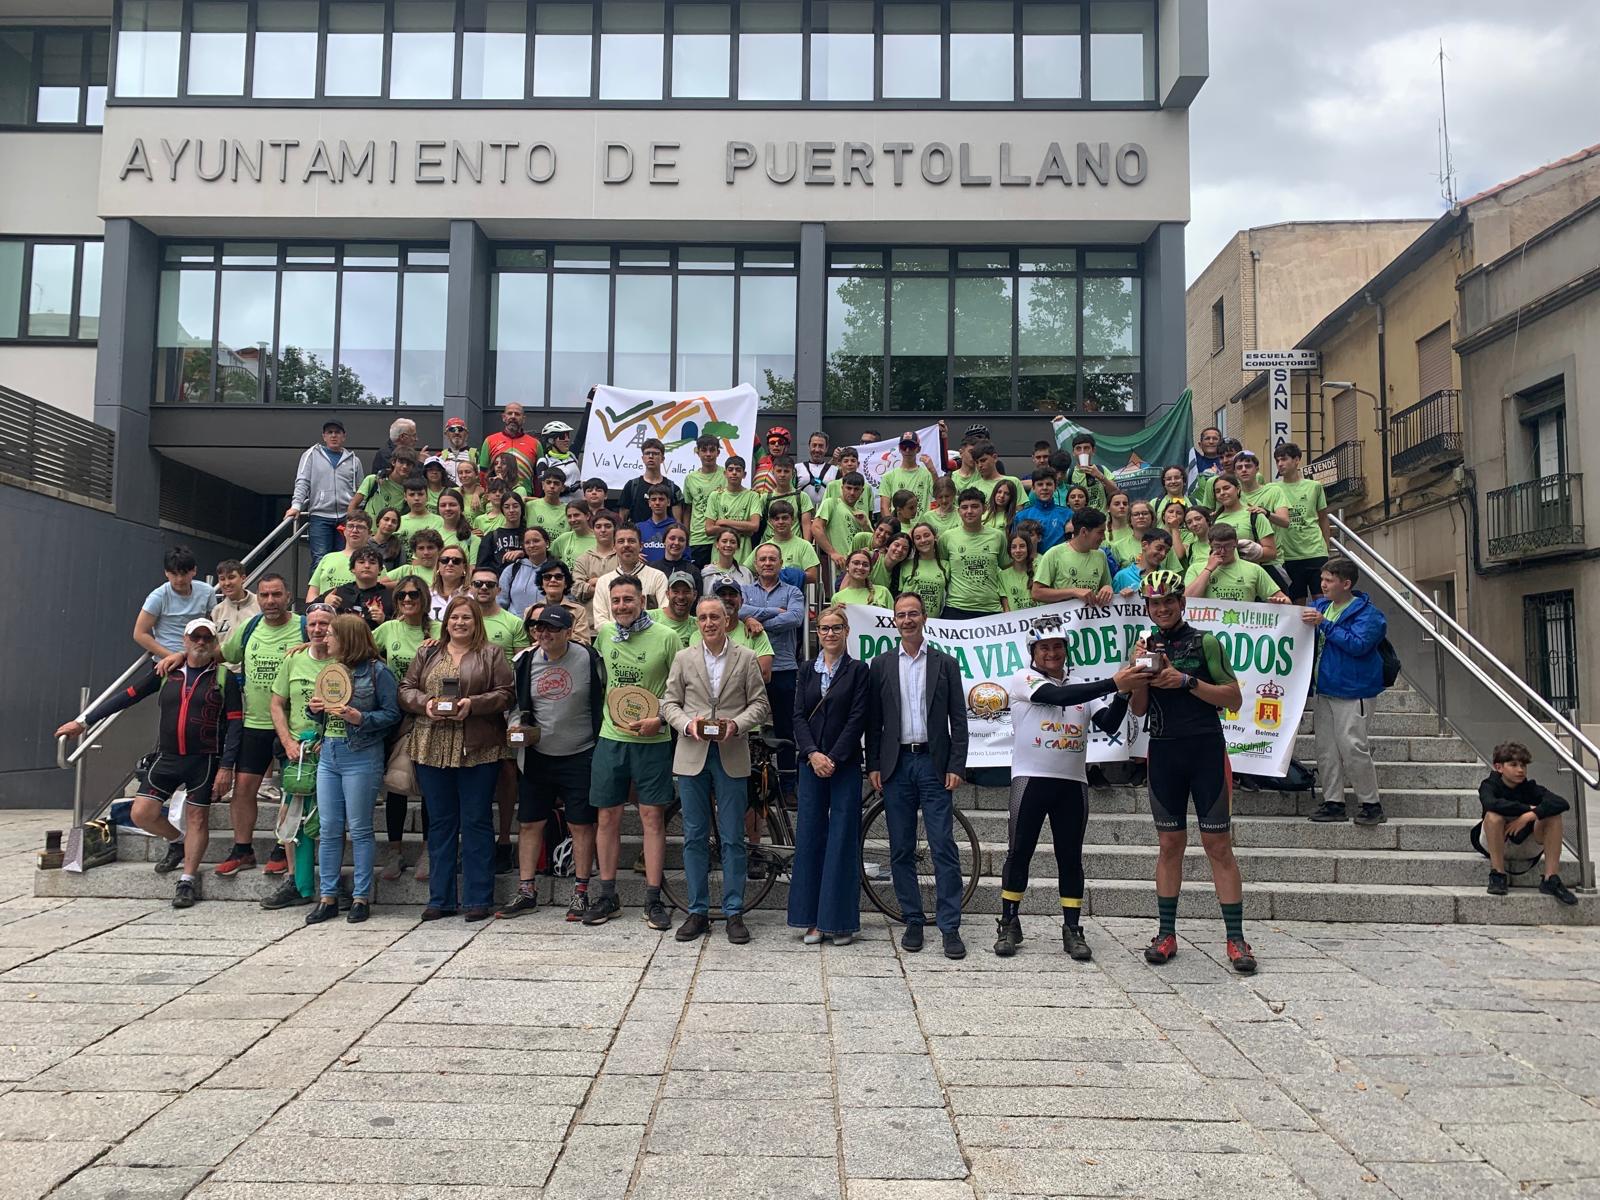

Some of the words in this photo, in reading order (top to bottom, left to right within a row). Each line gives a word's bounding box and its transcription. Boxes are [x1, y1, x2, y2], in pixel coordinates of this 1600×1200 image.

[119, 137, 558, 185] AYUNTAMIENTO
[602, 140, 681, 186] DE
[725, 140, 1149, 187] PUERTOLLANO
[1274, 368, 1288, 410] SAN
[613, 454, 644, 470] Verde
[662, 460, 687, 475] Valle
[1303, 466, 1313, 476] SE
[1313, 458, 1337, 473] VENDE
[643, 541, 665, 549] adida
[965, 569, 988, 577] VERDE
[921, 594, 937, 603] ERDE
[939, 622, 1017, 640] NACIONAL
[1074, 603, 1111, 620] VÍAS
[974, 641, 1025, 679] VIA
[1215, 631, 1294, 677] ODOS
[615, 669, 639, 679] SUEÑO
[1232, 724, 1246, 733] Rey
